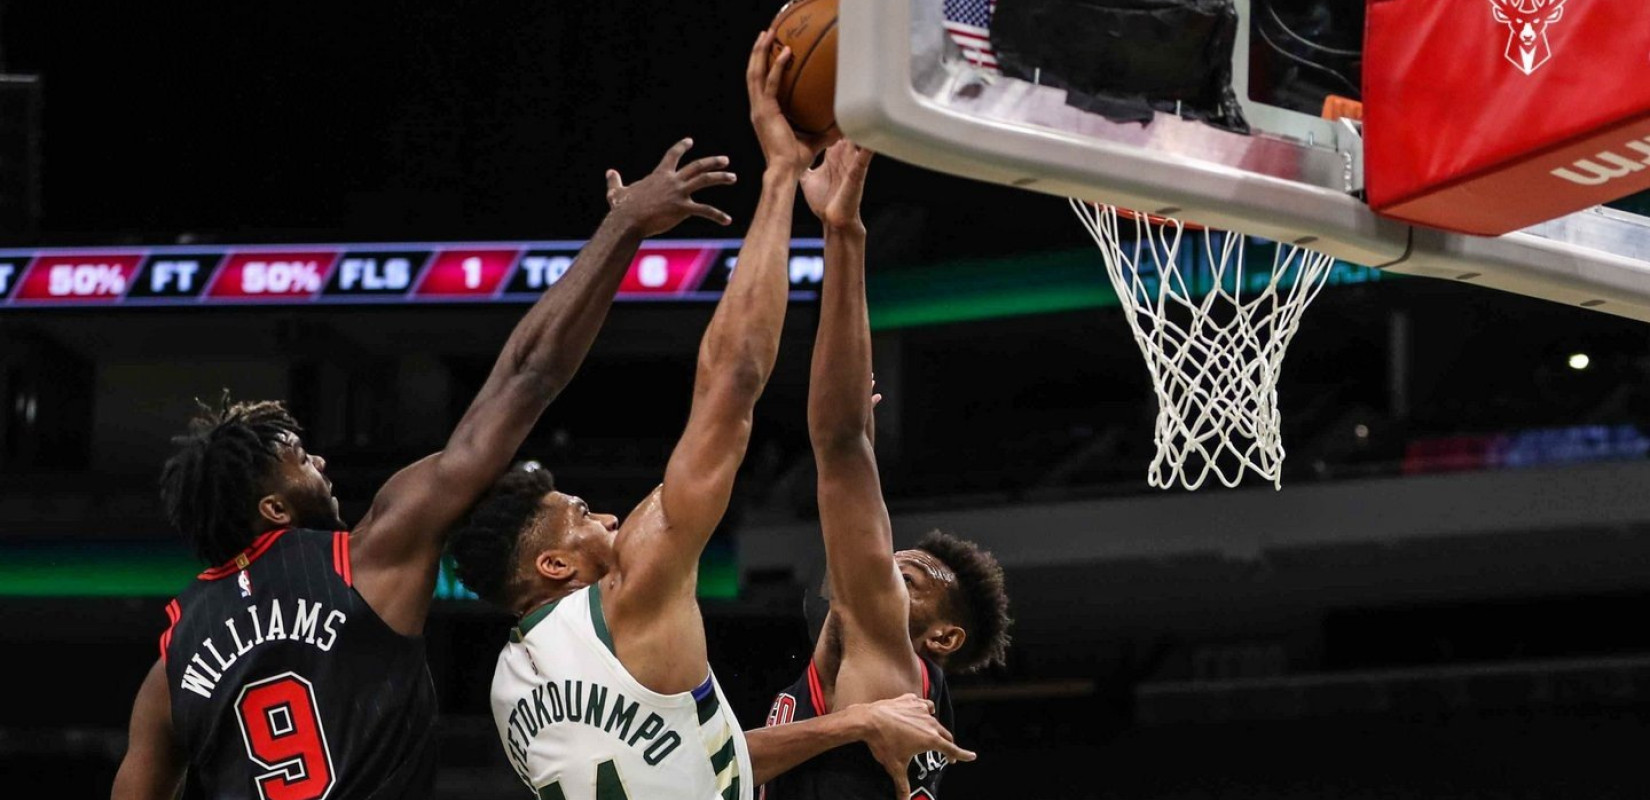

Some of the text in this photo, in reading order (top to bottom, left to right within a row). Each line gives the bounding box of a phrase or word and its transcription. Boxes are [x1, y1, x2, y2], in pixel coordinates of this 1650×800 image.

[48, 263, 126, 295] 50%
[151, 260, 199, 292] FT
[240, 260, 321, 293] 50%
[339, 258, 411, 290] FLS
[462, 256, 482, 289] 1
[637, 255, 668, 288] 6
[181, 598, 346, 699] WILLIAMS
[234, 671, 336, 800] 9
